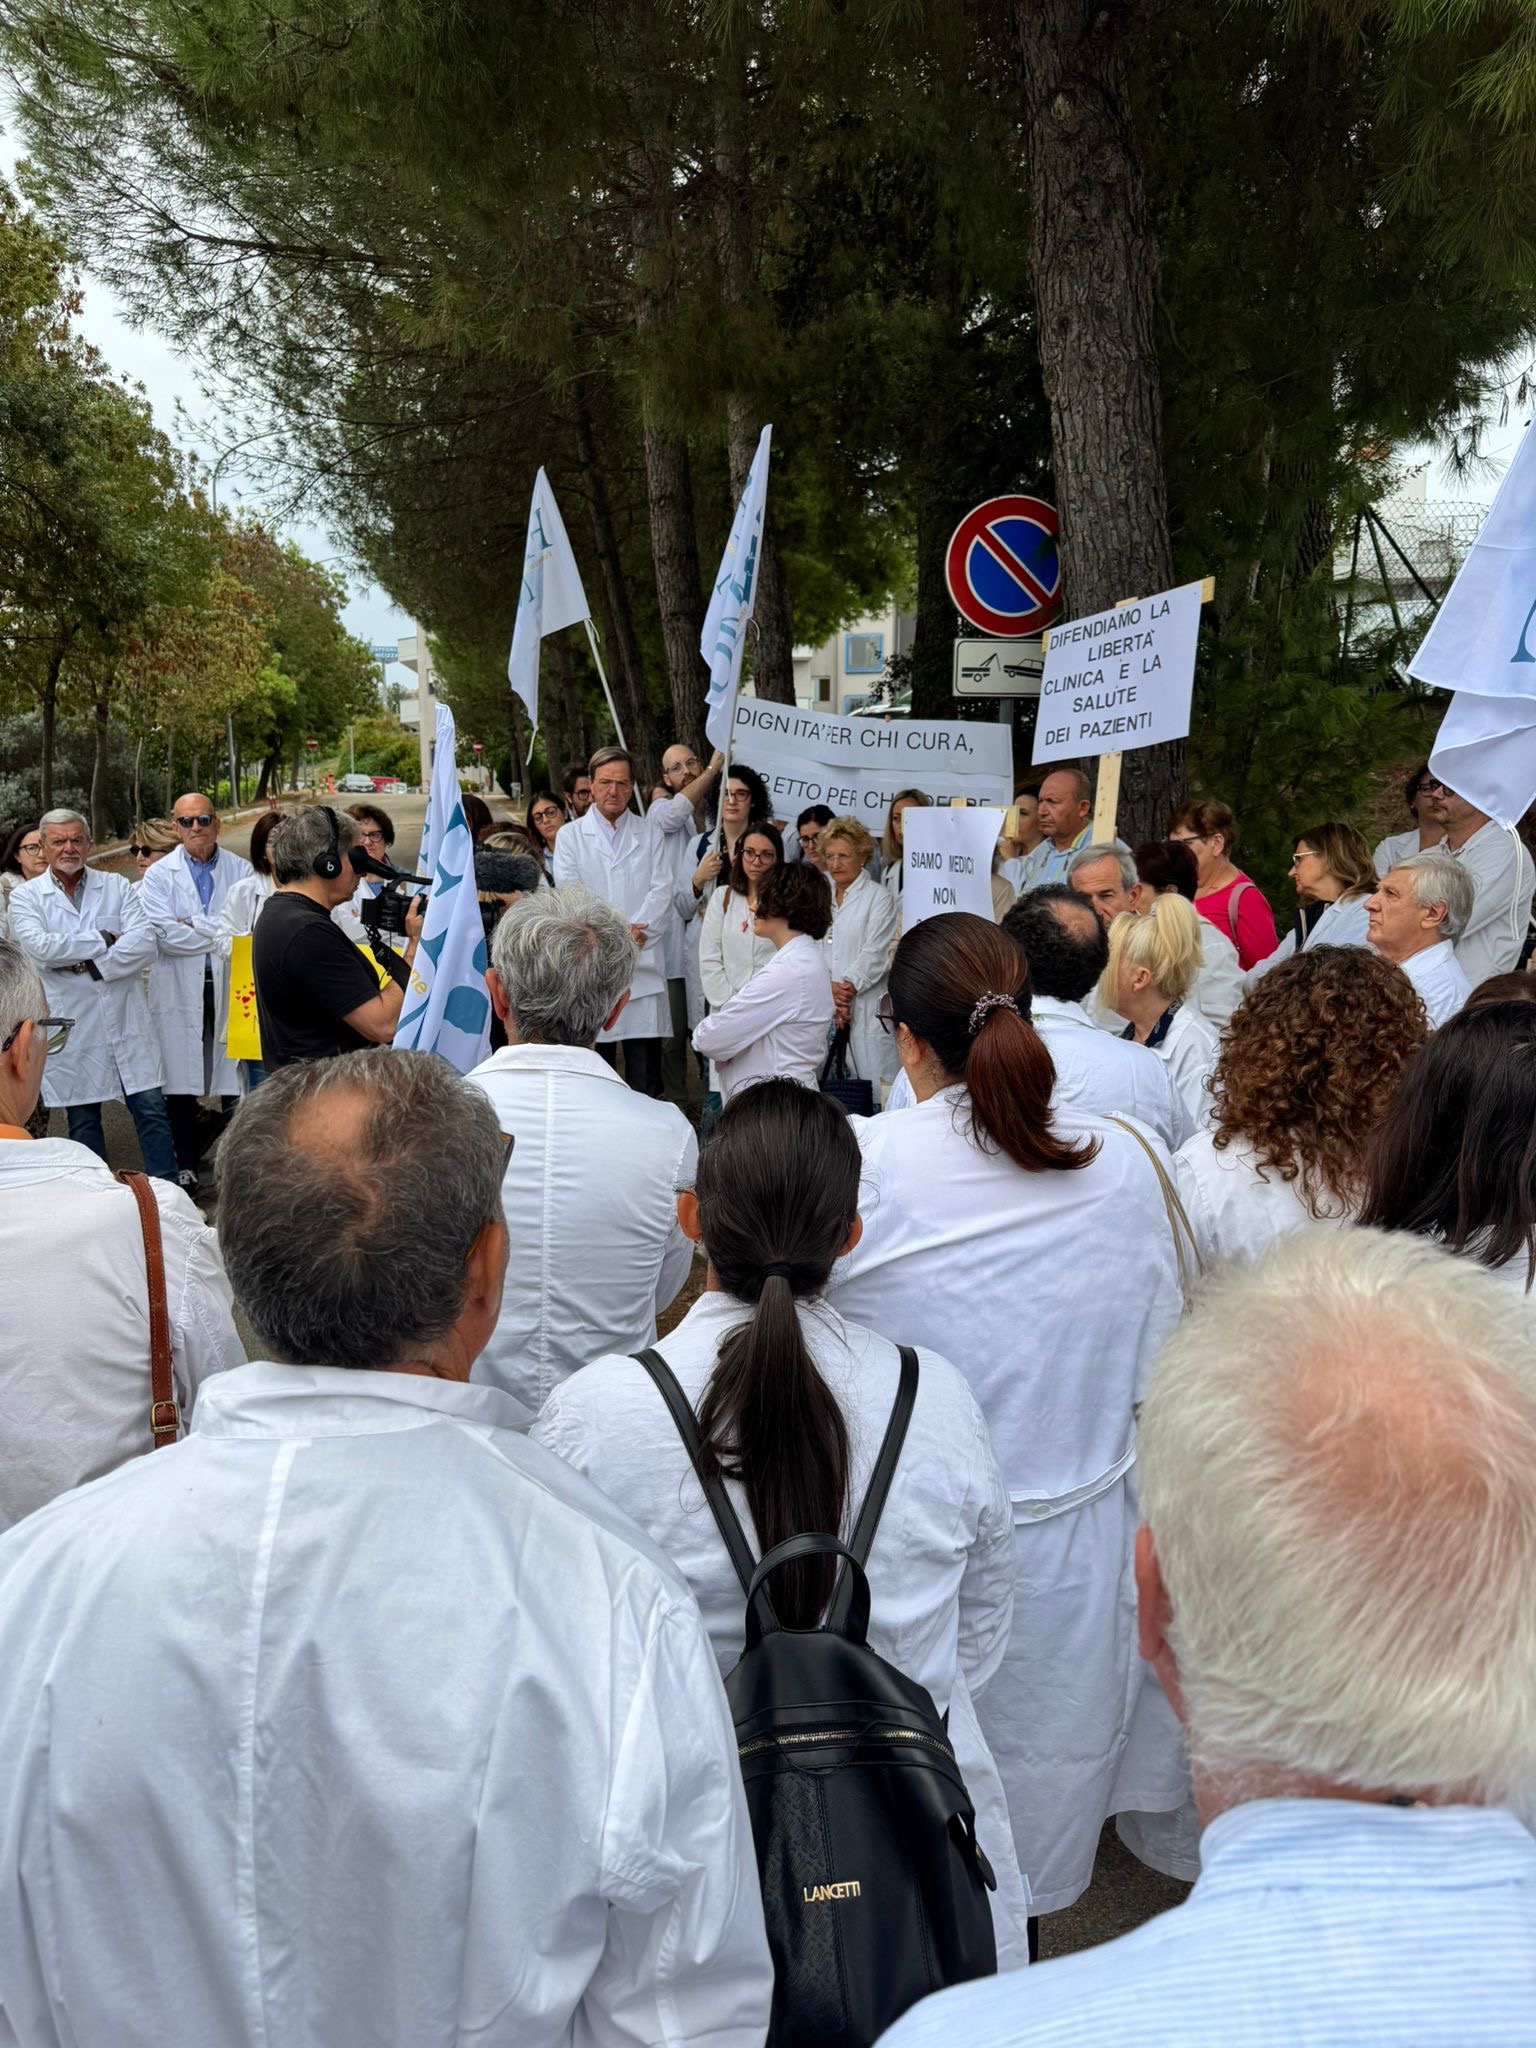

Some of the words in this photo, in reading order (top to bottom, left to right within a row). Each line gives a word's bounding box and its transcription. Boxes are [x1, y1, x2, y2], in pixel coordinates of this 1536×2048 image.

[1050, 607, 1142, 650] DIFENDIAMO
[1150, 599, 1171, 620] LA
[1044, 668, 1104, 696] CLINICA
[1119, 663, 1130, 680] E
[1142, 654, 1162, 674] LA
[1072, 686, 1137, 713] SALUTE
[1045, 726, 1070, 746] DEI
[1080, 711, 1152, 739] PAZIENTI
[860, 729, 899, 749] CHI
[906, 731, 974, 755] CURA,
[864, 790, 894, 809] CH
[911, 851, 943, 870] SIAMO
[948, 854, 975, 876] MEDICI
[932, 887, 957, 906] NON
[803, 1880, 861, 1903] LANCETTI
